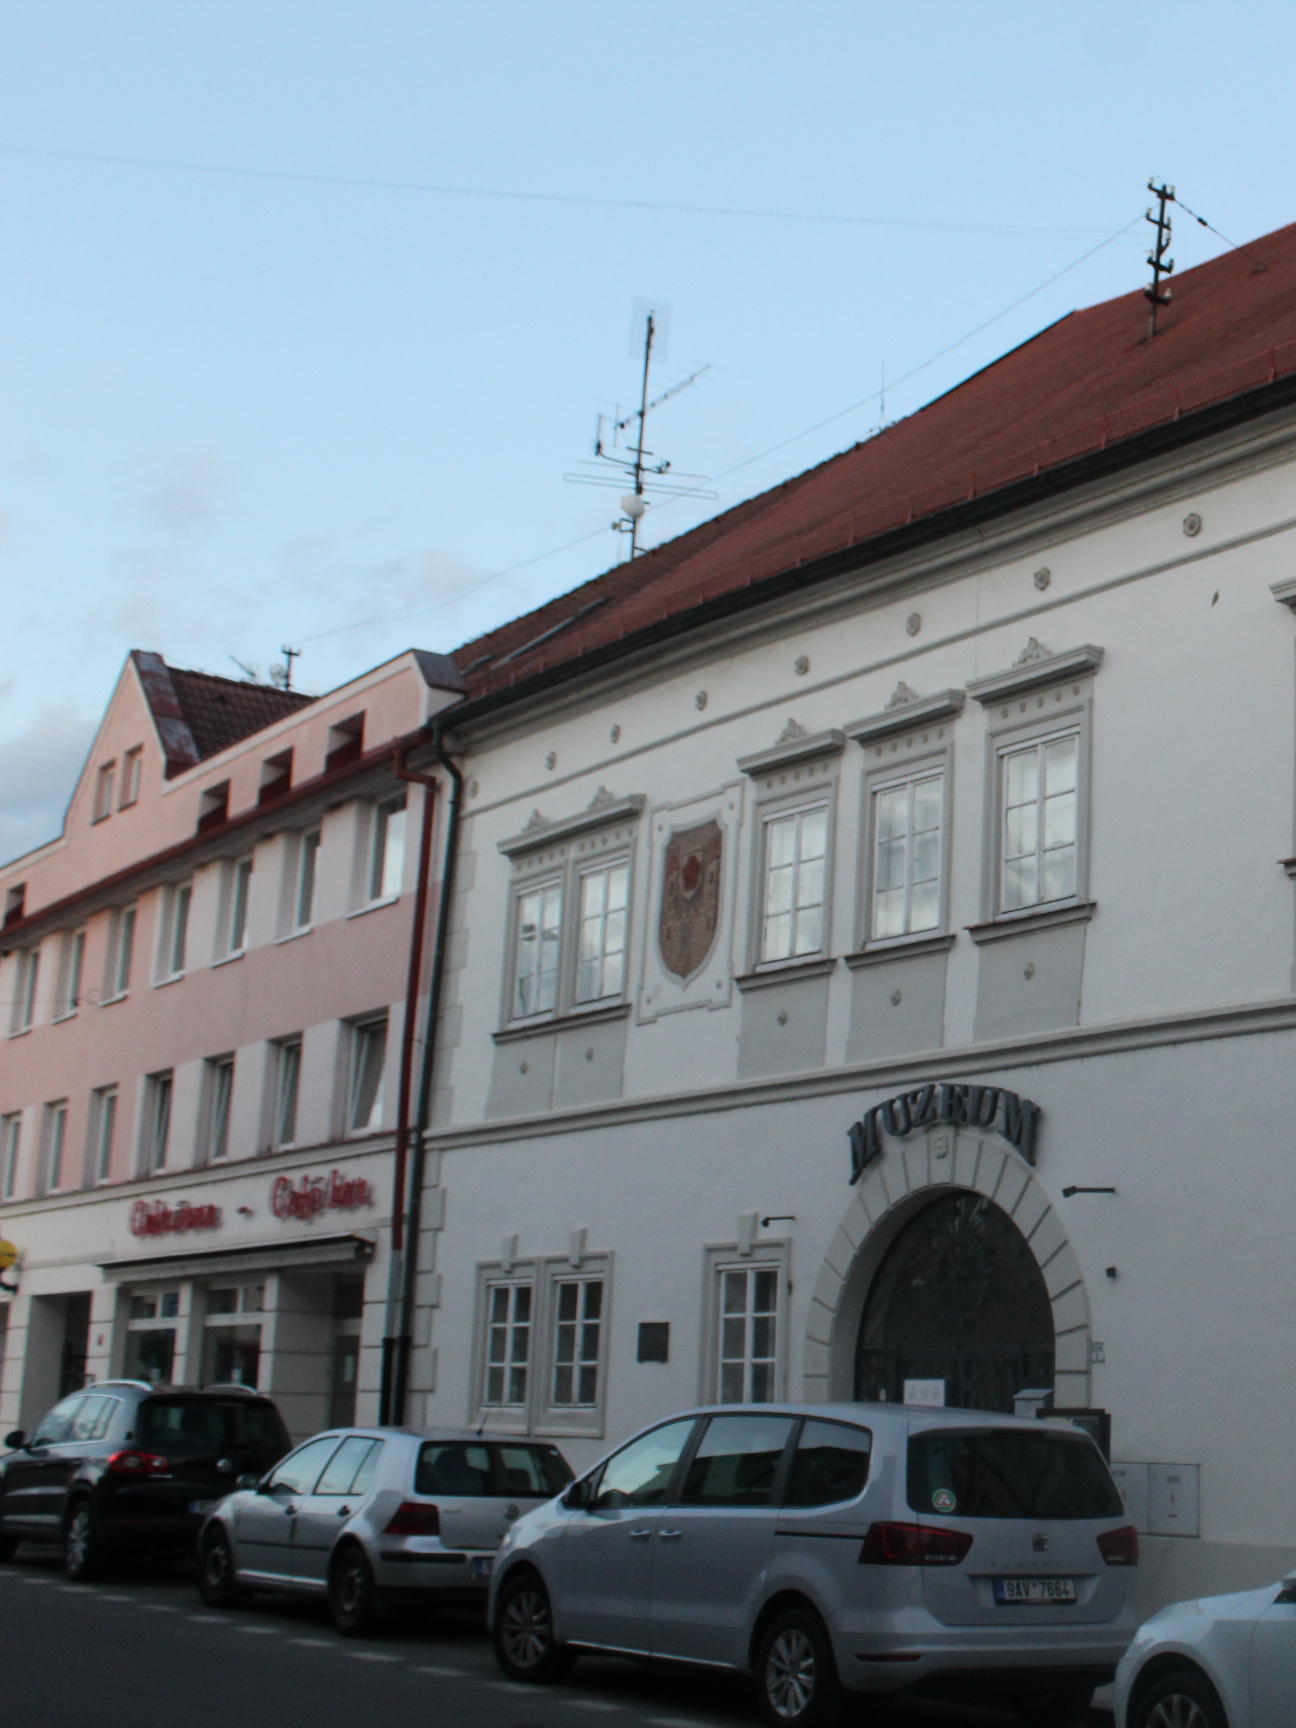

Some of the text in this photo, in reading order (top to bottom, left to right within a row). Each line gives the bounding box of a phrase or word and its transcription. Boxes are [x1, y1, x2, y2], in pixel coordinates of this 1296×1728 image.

[847, 1083, 1042, 1186] MUZEUM
[1006, 1581, 1070, 1597] 9AV 7664
